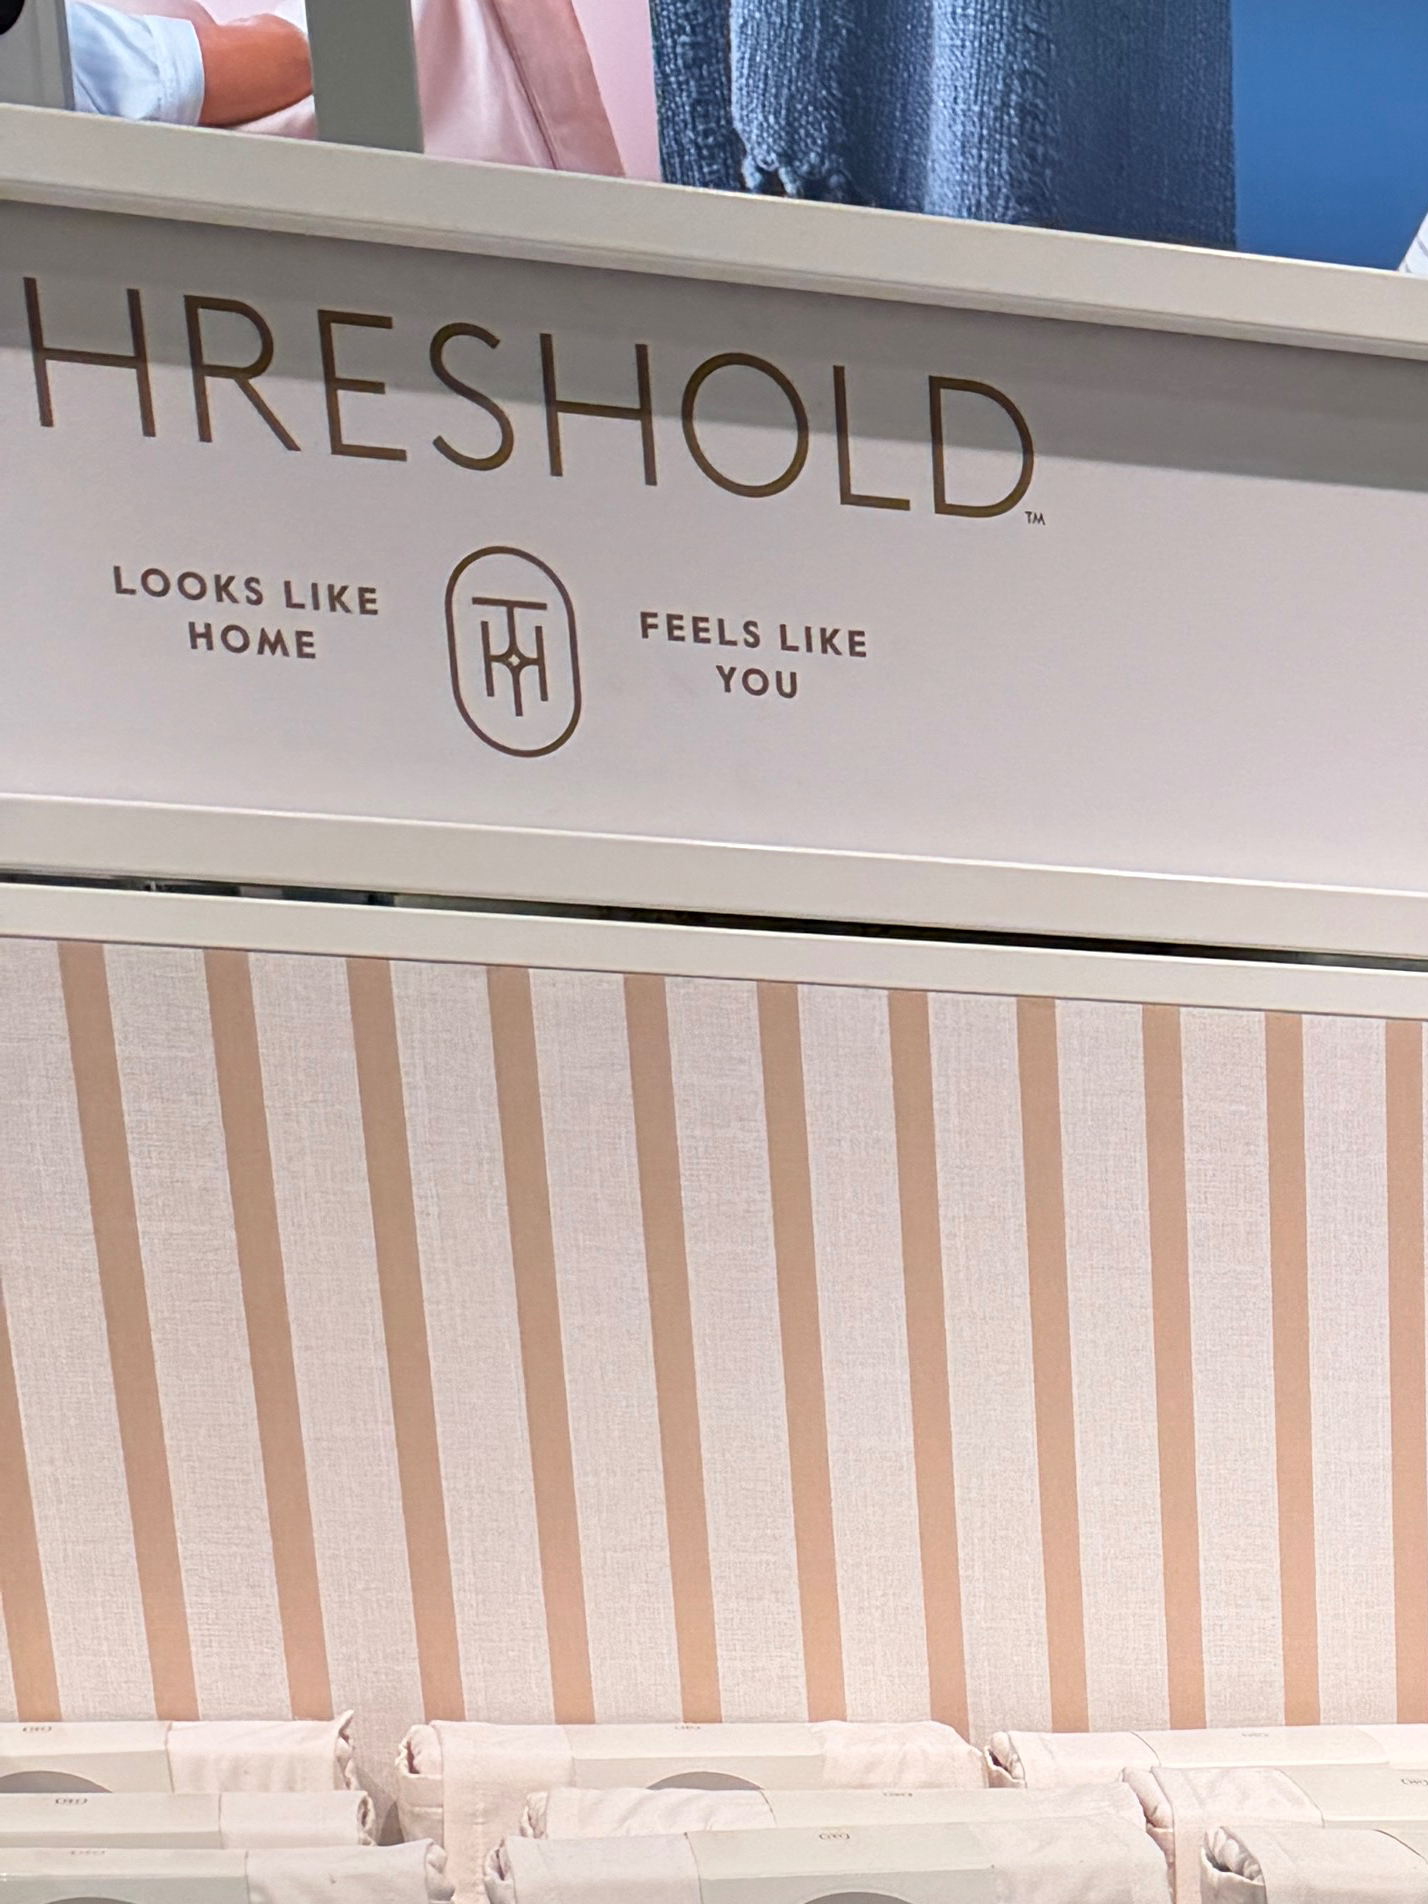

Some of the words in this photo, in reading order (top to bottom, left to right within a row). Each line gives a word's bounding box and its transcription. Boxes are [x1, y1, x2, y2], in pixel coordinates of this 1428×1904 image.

[22, 275, 1036, 520] HRESHOLD
[112, 563, 266, 608] LOOKS
[282, 579, 381, 616] LIKE
[188, 621, 318, 661] HOME
[639, 610, 763, 651] FEELS
[779, 623, 870, 659] LIKE
[715, 664, 800, 701] YOU
